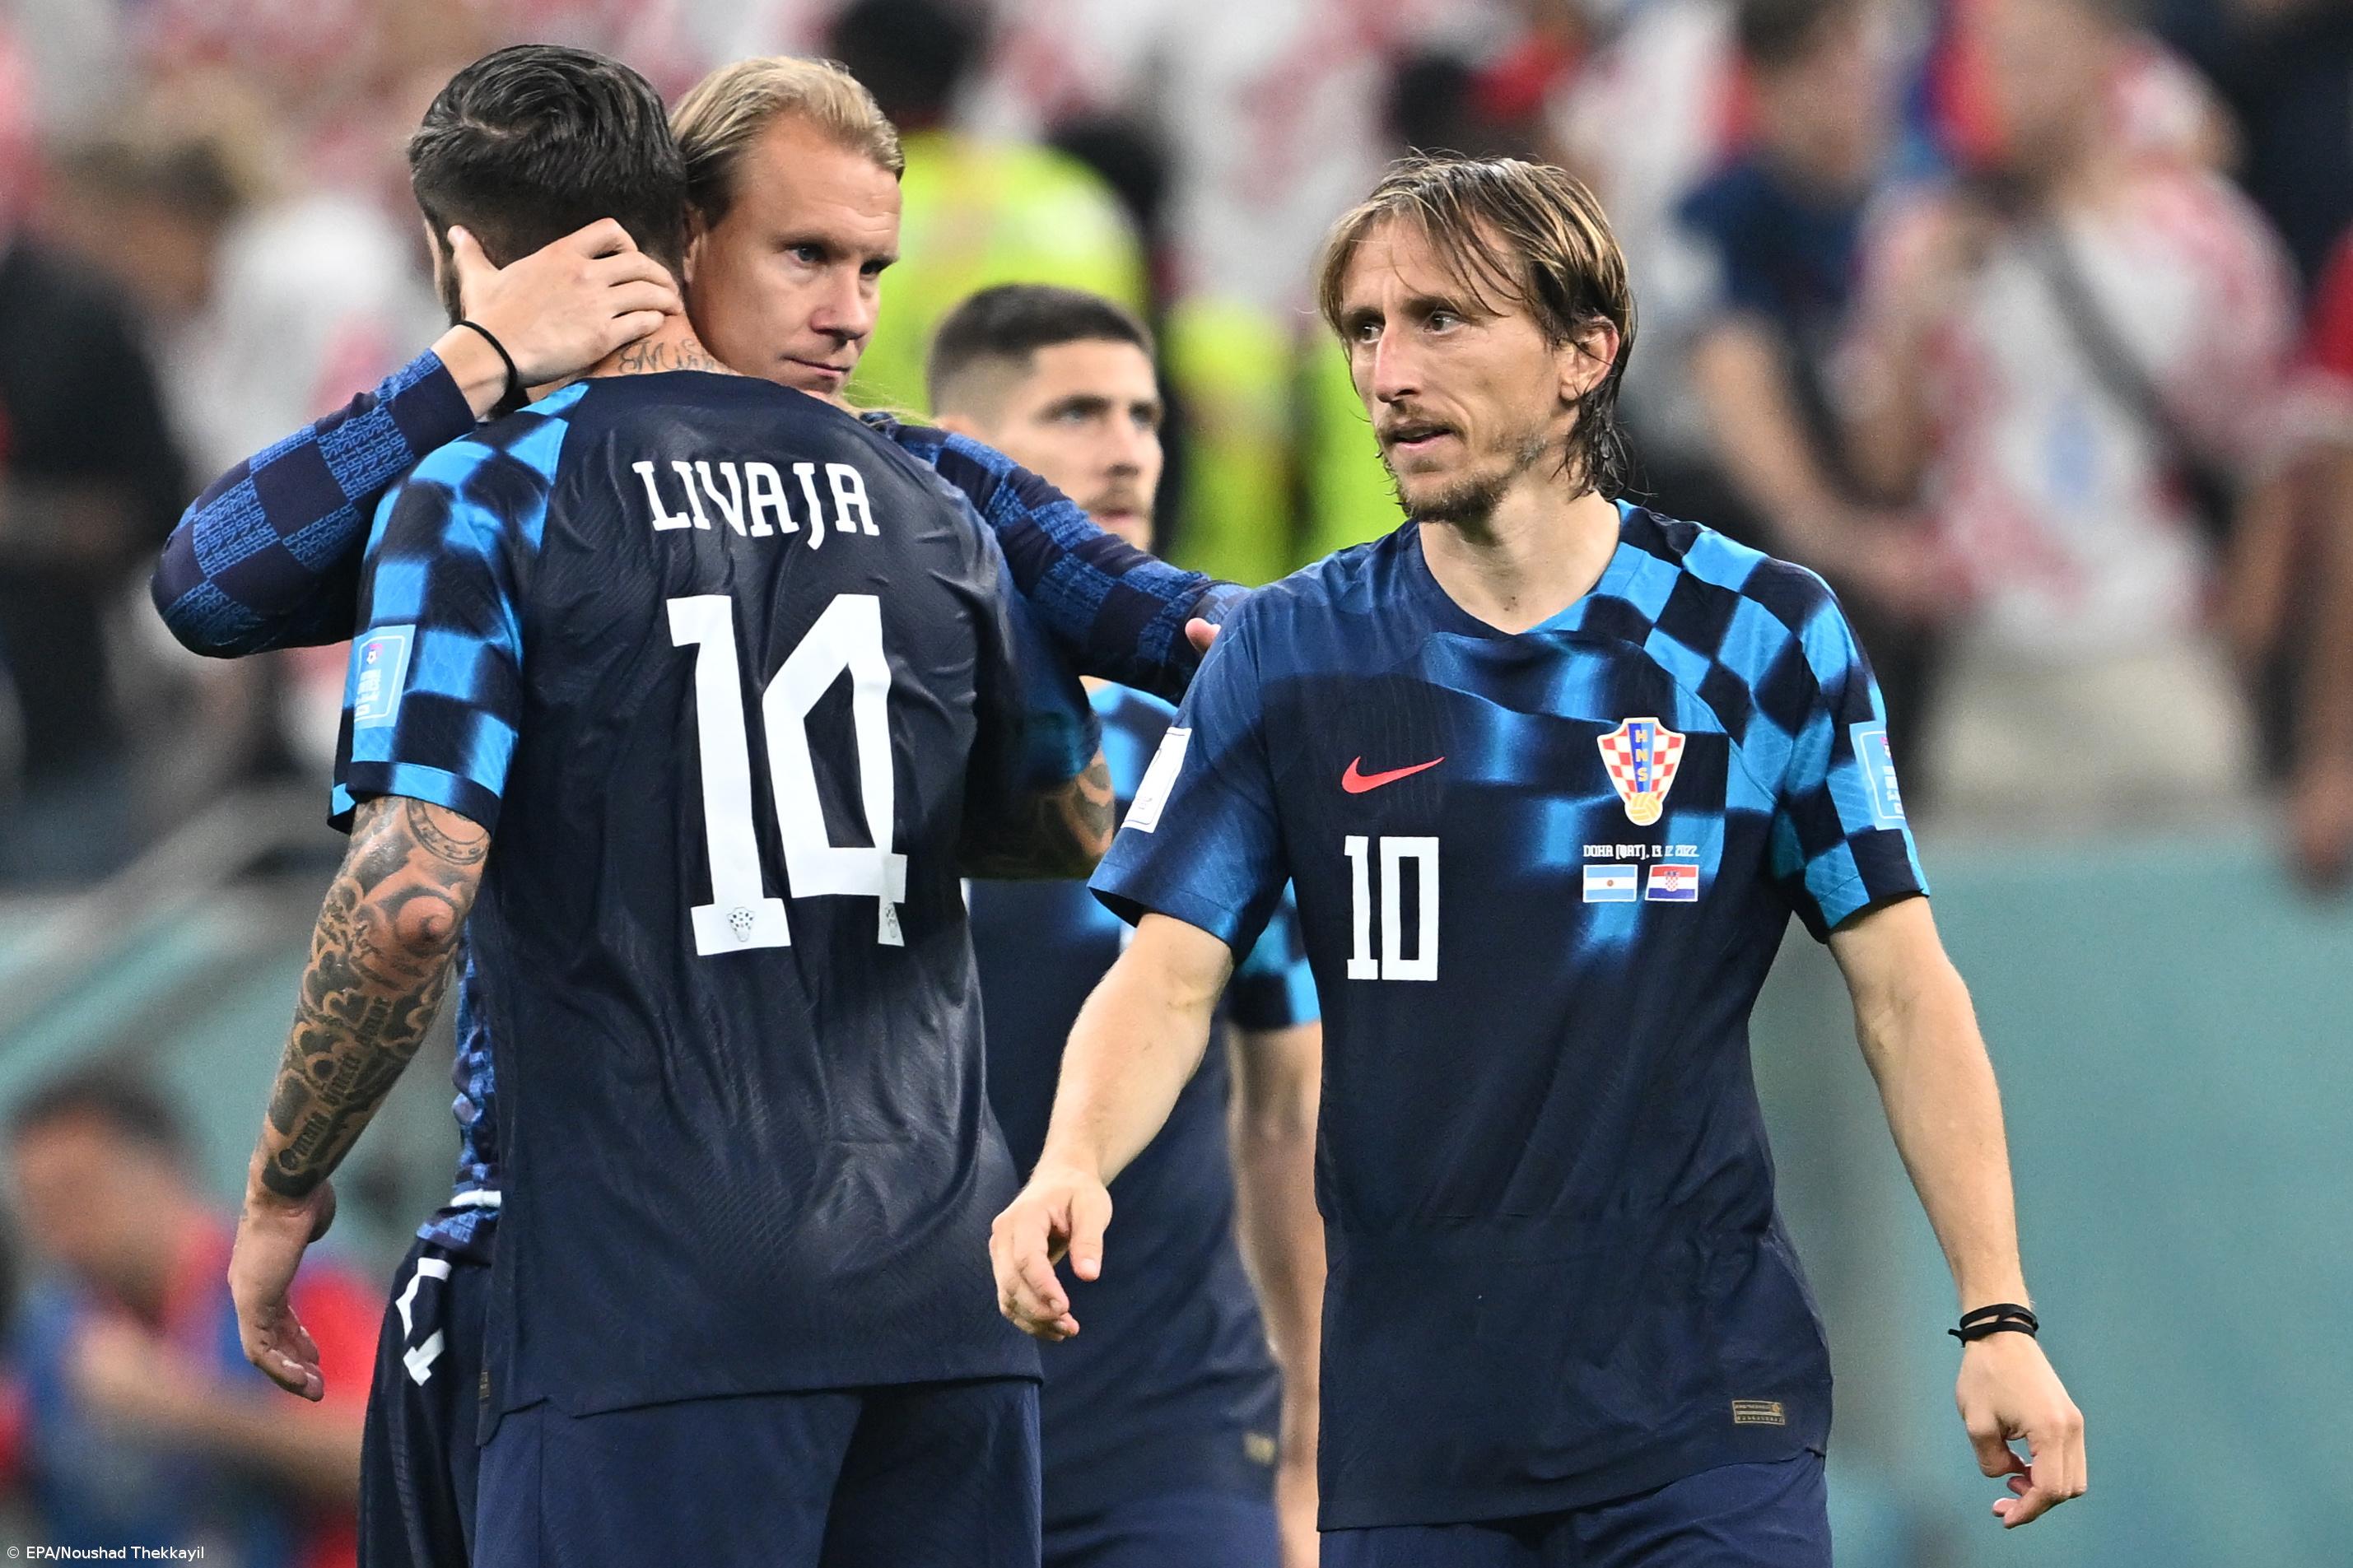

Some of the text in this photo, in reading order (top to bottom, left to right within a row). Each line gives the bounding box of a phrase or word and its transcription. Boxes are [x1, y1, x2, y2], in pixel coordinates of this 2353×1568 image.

[631, 460, 880, 551] LIVAJA
[666, 593, 908, 956] 14
[1634, 729, 1649, 782] HNS
[1583, 844, 1614, 857] DOHA
[1344, 835, 1439, 981] 10
